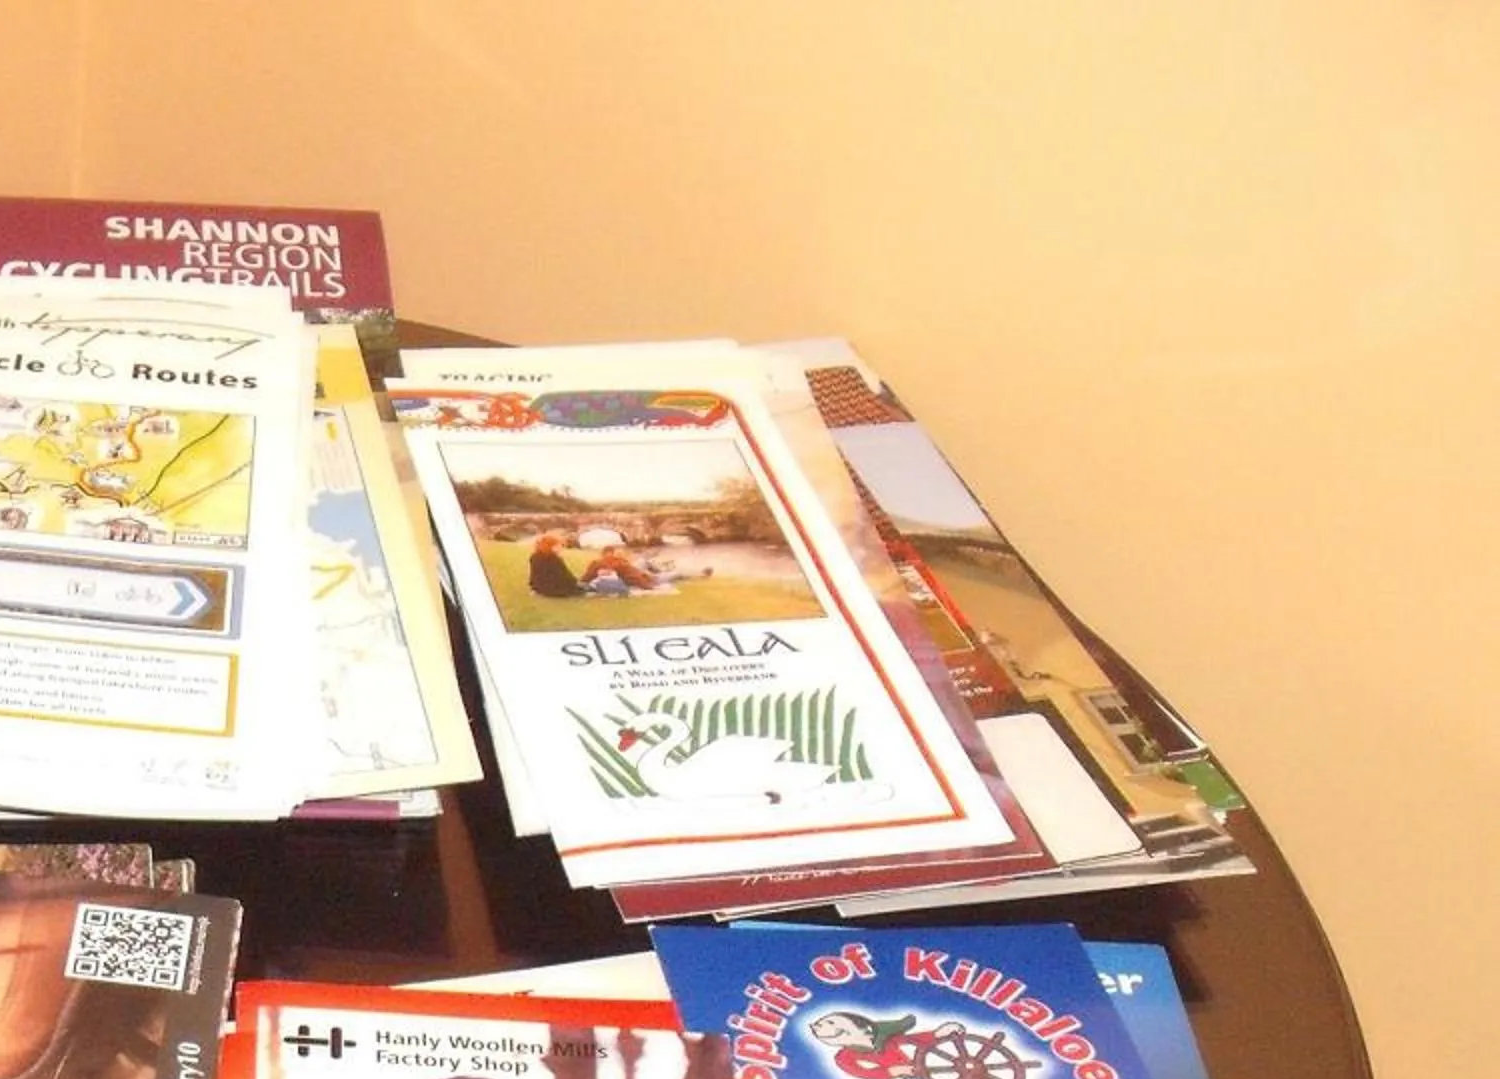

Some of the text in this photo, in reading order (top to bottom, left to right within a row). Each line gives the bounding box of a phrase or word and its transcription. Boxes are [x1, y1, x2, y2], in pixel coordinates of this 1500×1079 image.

[105, 216, 339, 245] SHANNON
[183, 242, 341, 270] REGION
[131, 363, 259, 390] Routes
[809, 942, 877, 984] of
[376, 1030, 608, 1059] Hanly Woollen Mills
[376, 1050, 529, 1075] Factory Shop
